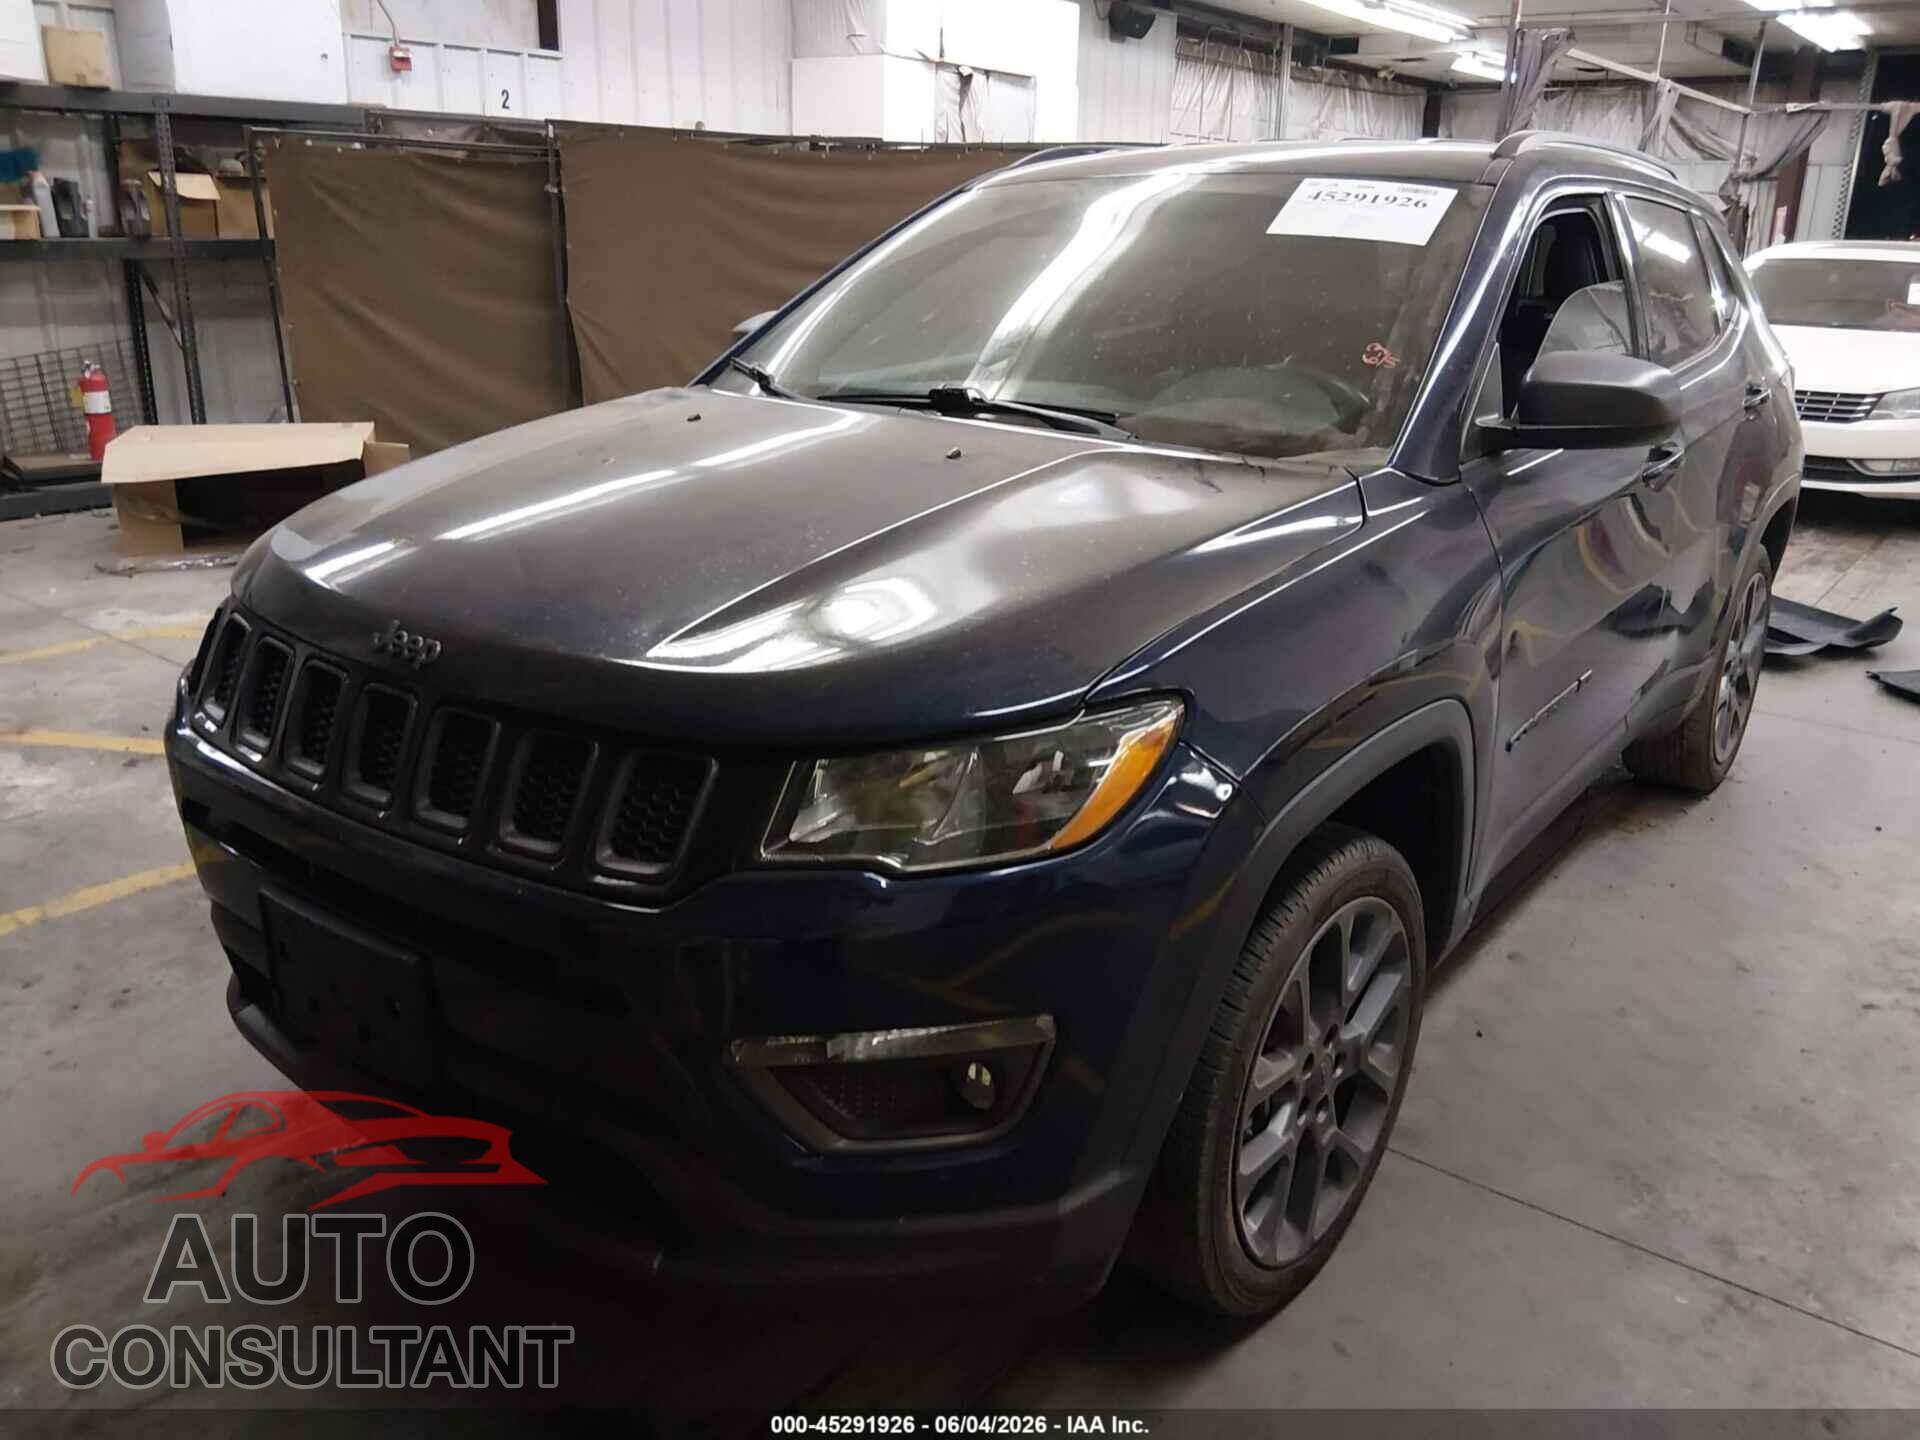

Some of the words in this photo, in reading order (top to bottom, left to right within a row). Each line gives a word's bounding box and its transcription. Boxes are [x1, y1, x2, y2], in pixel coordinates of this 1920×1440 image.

[500, 88, 510, 110] 2
[1307, 189, 1429, 209] 45291926
[368, 619, 442, 671] Jeep
